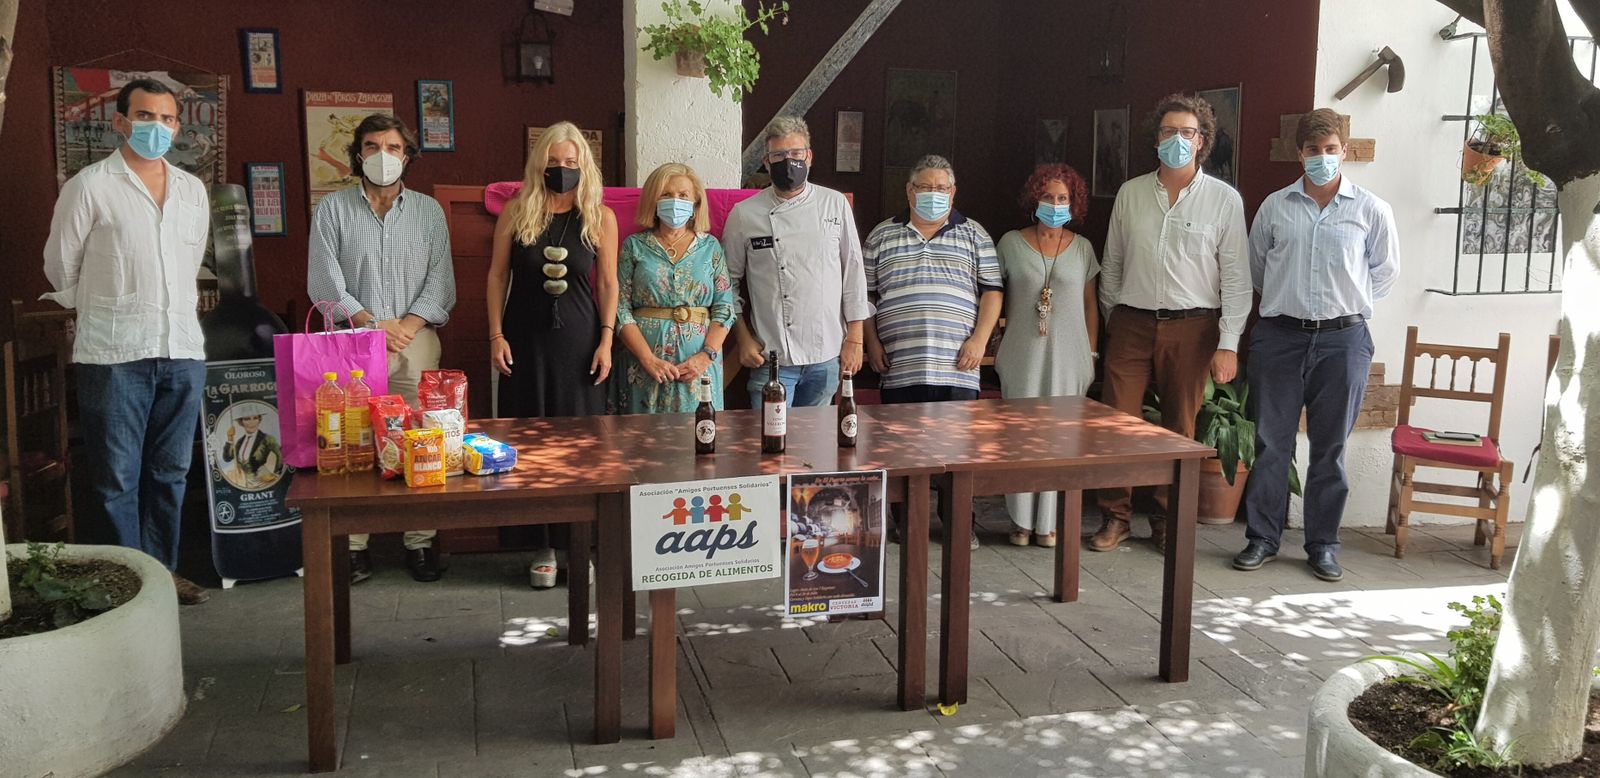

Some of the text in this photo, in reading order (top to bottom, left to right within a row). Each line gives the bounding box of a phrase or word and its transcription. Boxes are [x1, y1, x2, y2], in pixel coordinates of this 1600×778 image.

[333, 92, 356, 103] TOROS
[357, 92, 393, 104] ZARAGOZA
[224, 370, 266, 380] OLOROSO
[413, 460, 442, 471] BLANCO
[240, 490, 274, 502] GRANT
[639, 488, 673, 496] Asociación
[674, 487, 701, 495] "Amigos
[703, 484, 738, 492] Portuenses
[655, 520, 759, 559] aaps
[641, 564, 773, 583] RECOGIDA DE ALIMENTOS
[655, 564, 683, 572] Asociación
[790, 602, 826, 613] makro
